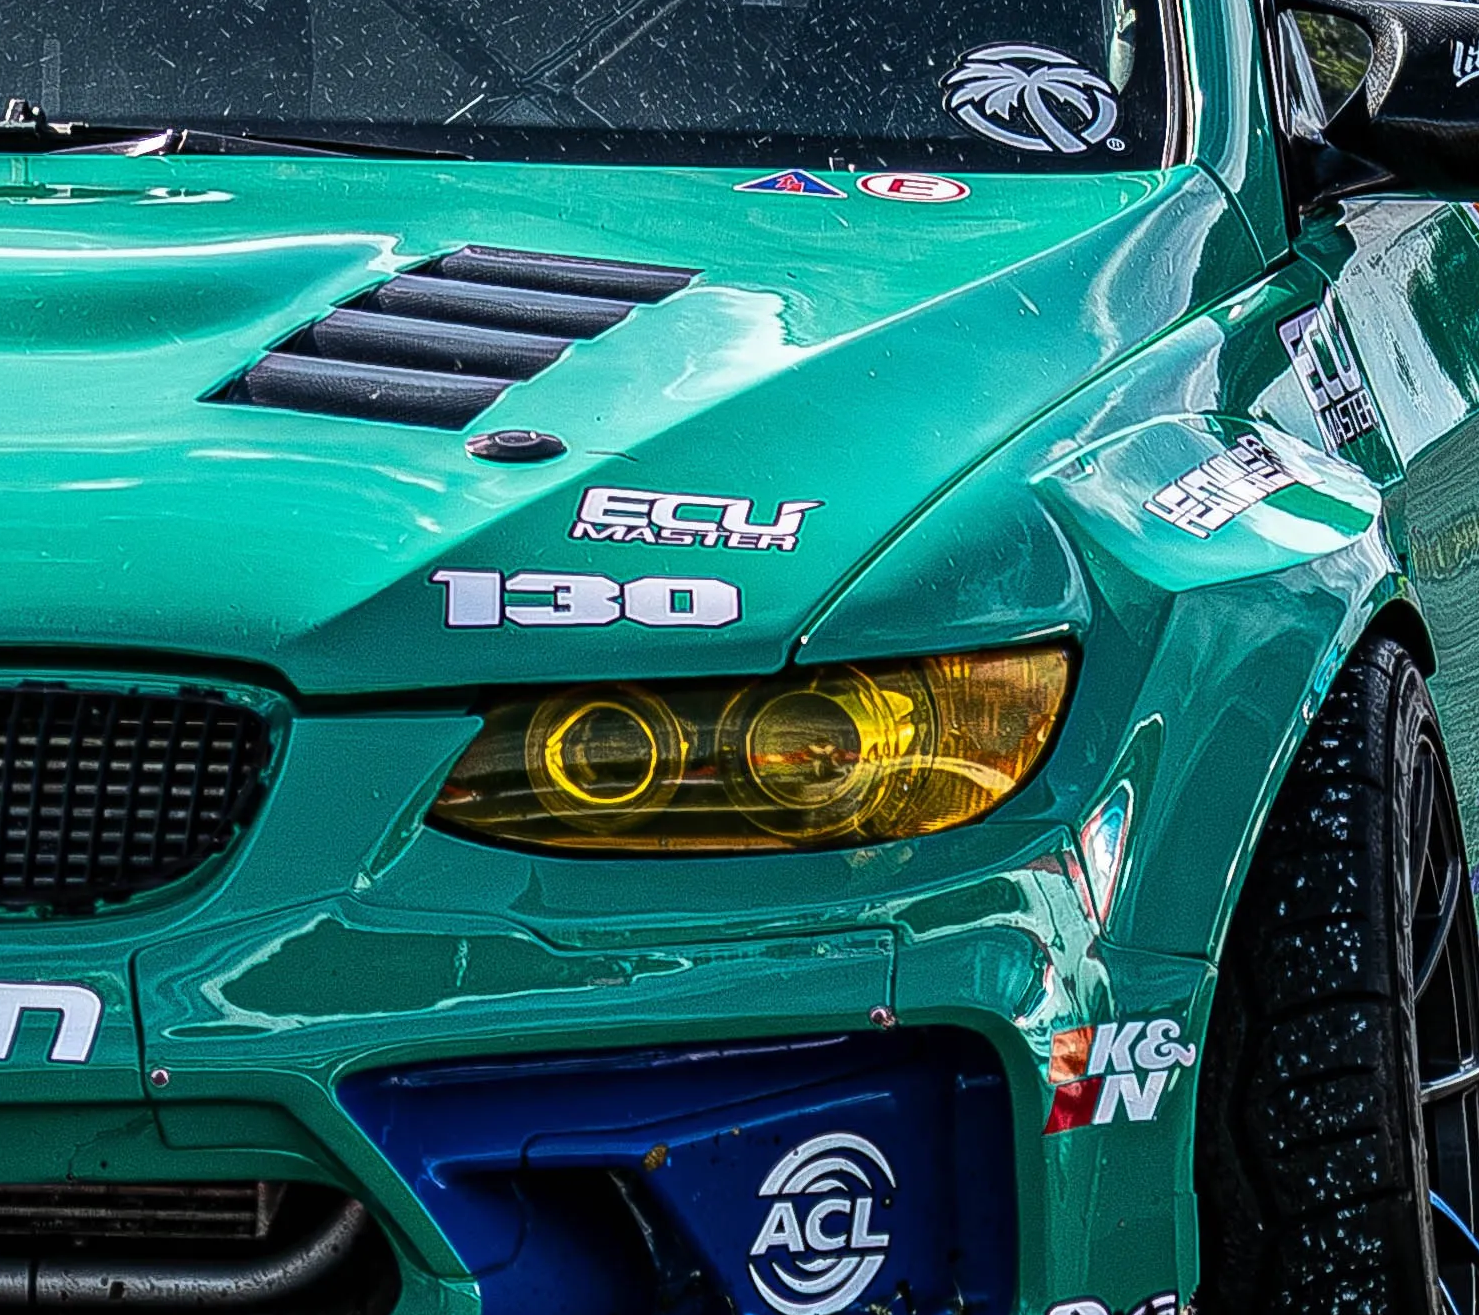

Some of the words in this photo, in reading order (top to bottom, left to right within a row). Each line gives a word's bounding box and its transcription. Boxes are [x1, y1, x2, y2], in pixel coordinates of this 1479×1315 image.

[1278, 287, 1362, 412] ECU
[1315, 390, 1379, 456] MASTER
[572, 522, 796, 551] MASTER
[581, 488, 825, 535] ECU
[433, 570, 742, 628] 130
